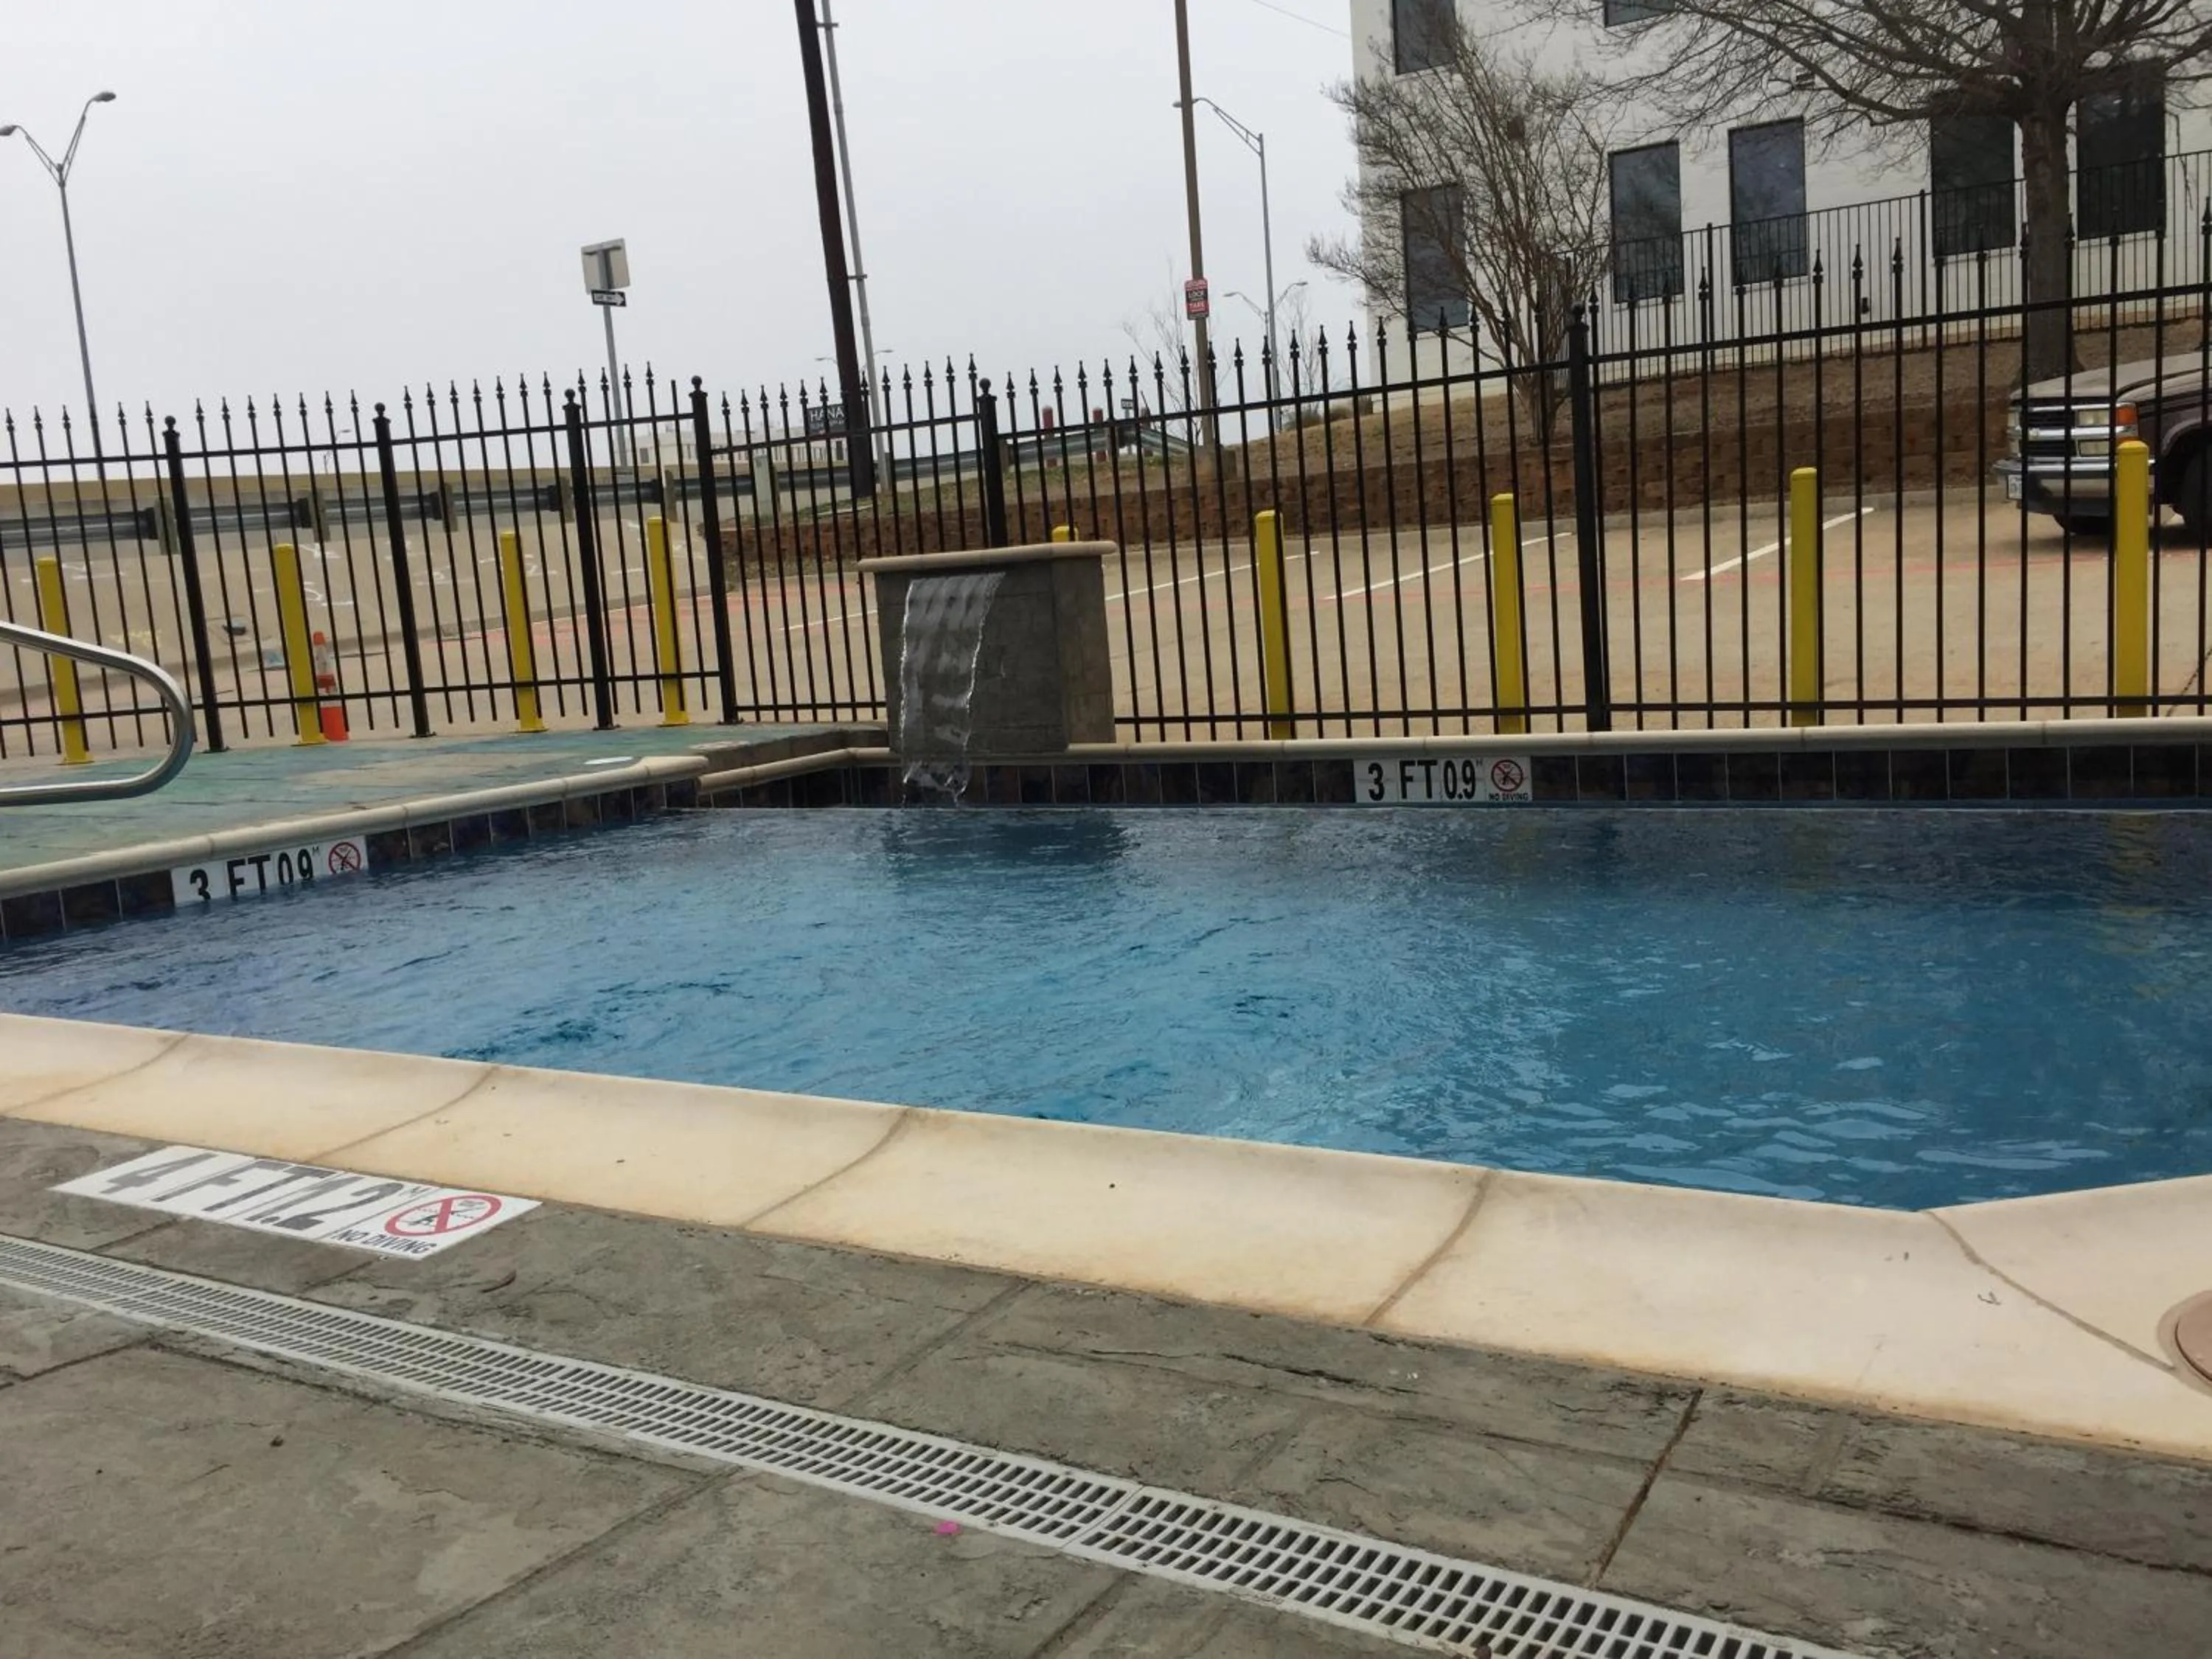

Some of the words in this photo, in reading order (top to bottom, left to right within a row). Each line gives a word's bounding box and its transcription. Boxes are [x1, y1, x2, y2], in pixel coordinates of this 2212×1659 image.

[1368, 762, 1385, 801] 3
[1399, 759, 1438, 799] FT
[1489, 793, 1499, 801] NO
[226, 854, 271, 900] FT
[100, 1152, 221, 1194] 4
[152, 1159, 339, 1211] FT
[330, 1229, 369, 1242] NO
[361, 1234, 437, 1253] DIVING
